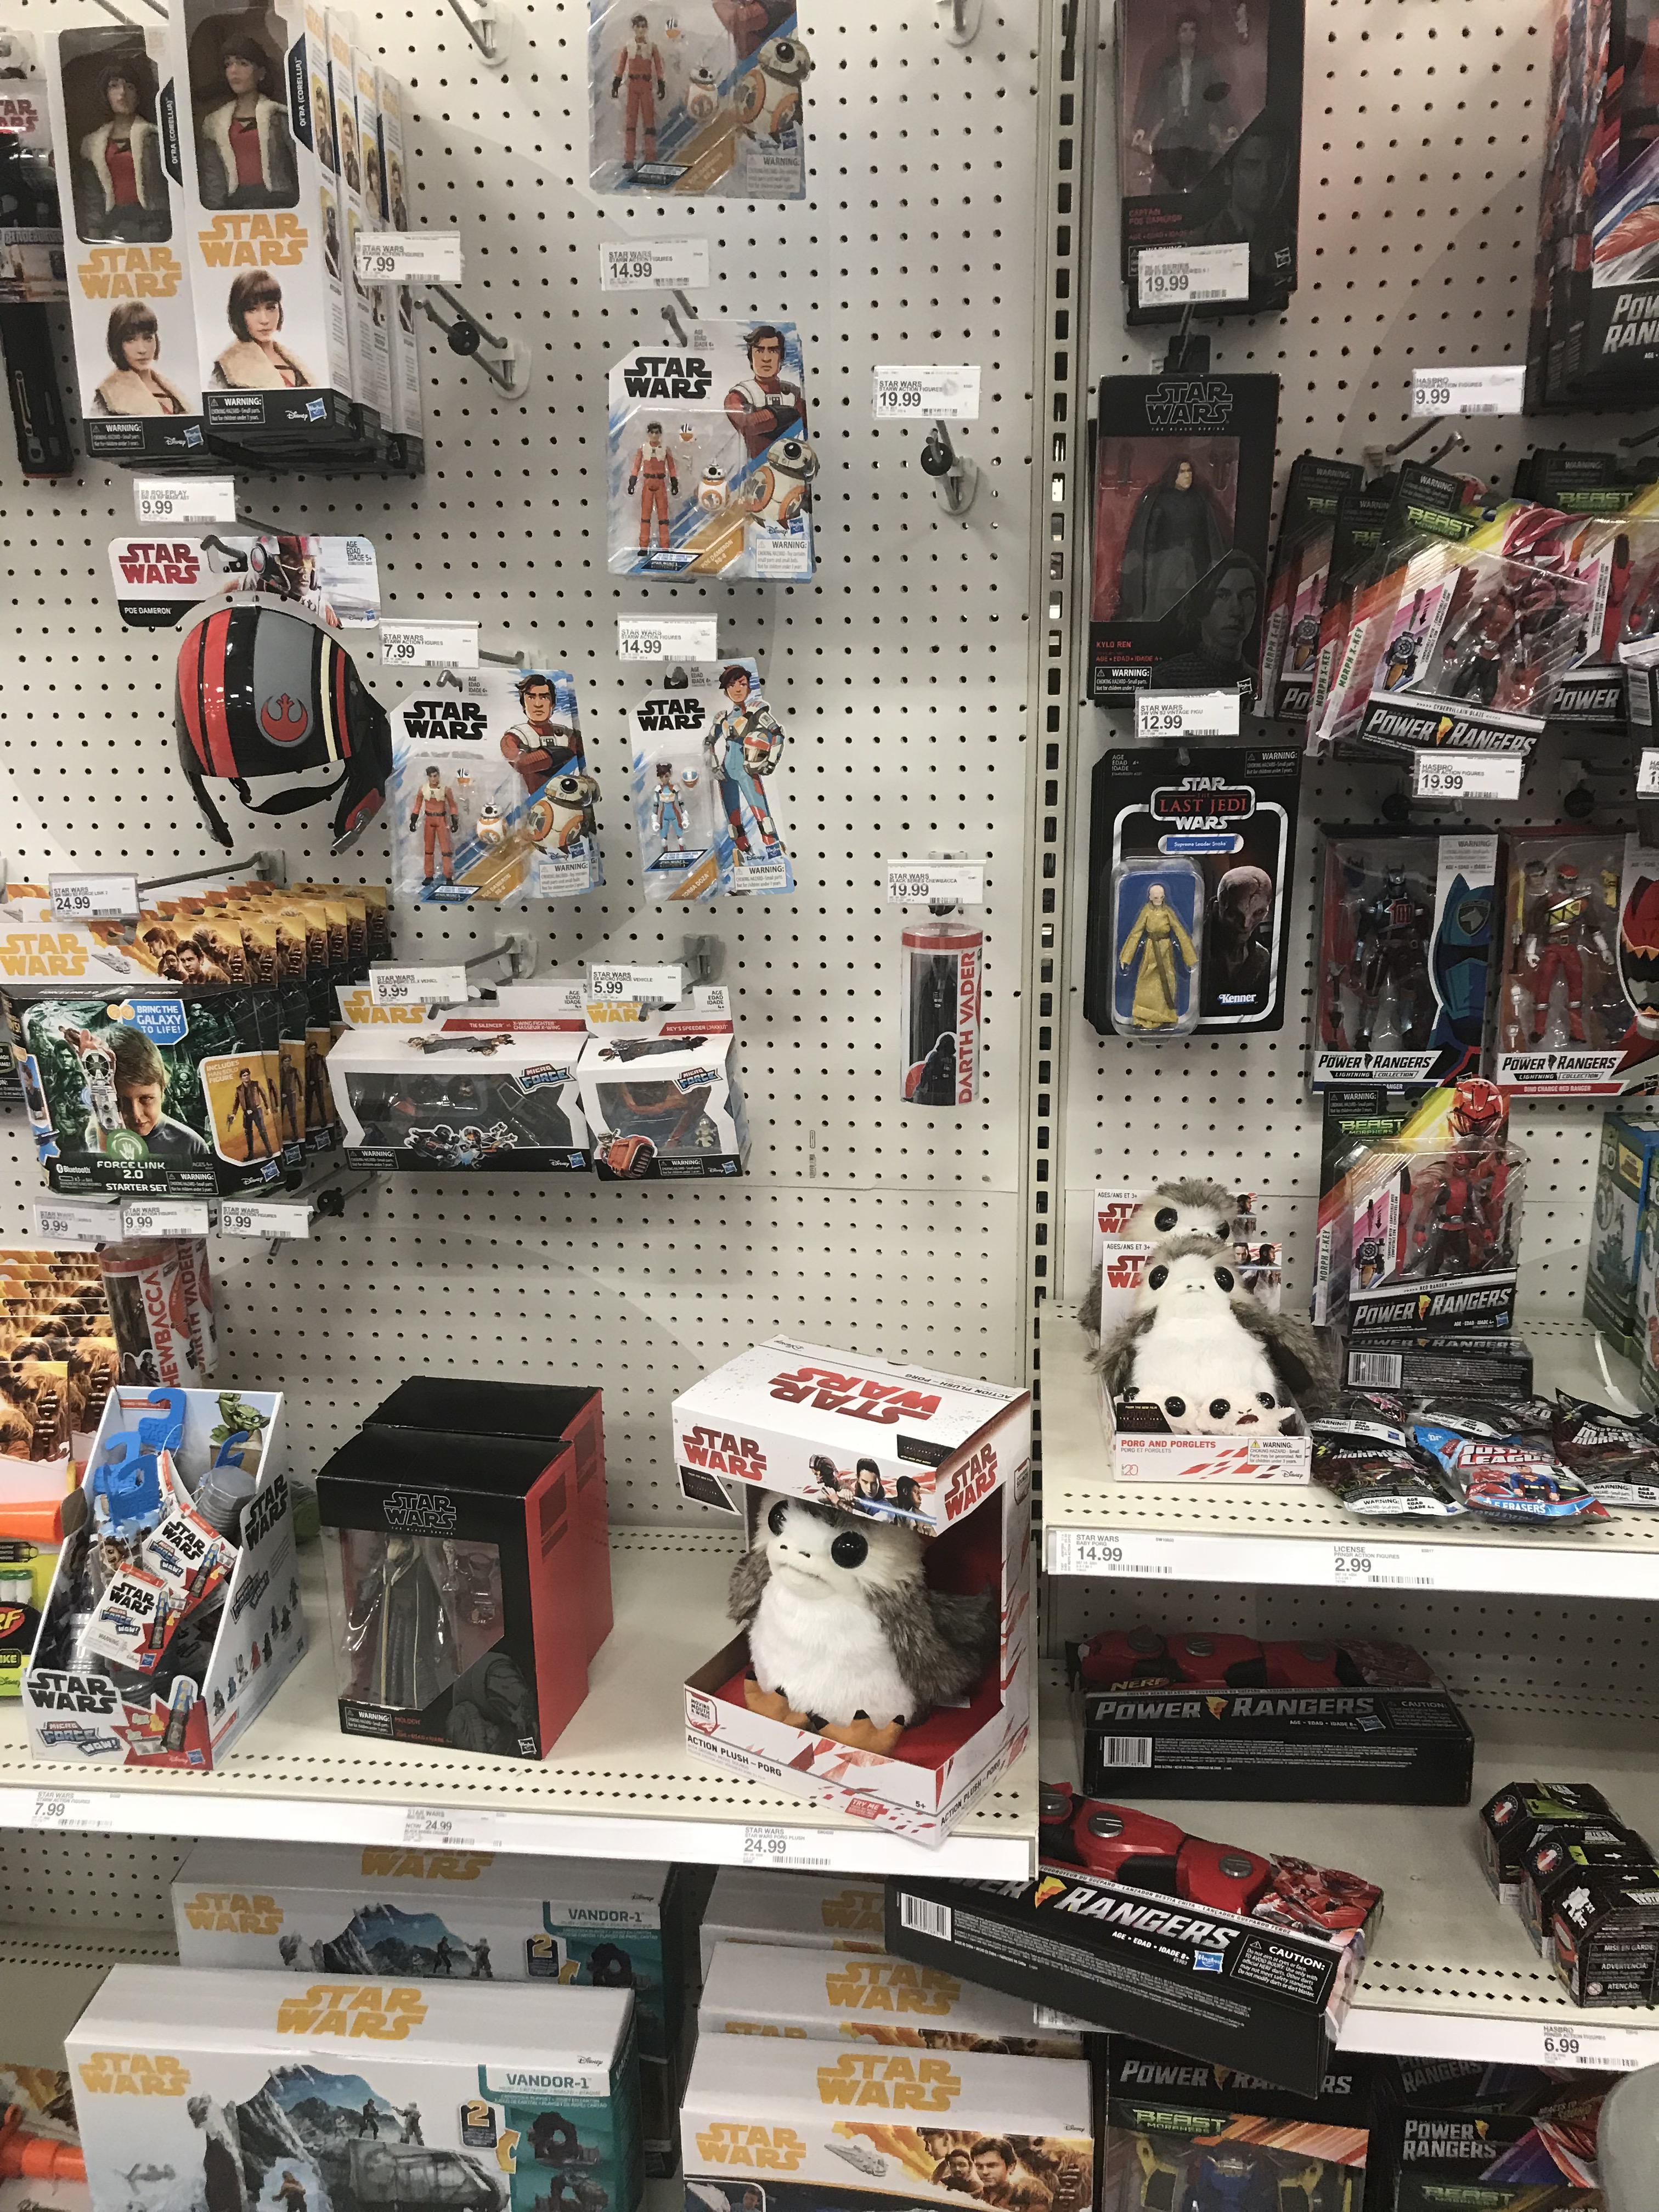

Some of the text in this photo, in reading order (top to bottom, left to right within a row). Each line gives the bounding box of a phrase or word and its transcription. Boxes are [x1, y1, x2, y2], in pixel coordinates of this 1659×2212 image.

[198, 214, 307, 240] STAR
[77, 247, 181, 273] STAR
[200, 240, 309, 267] WARS
[363, 257, 394, 271] 7.99
[610, 263, 652, 278] 14.99
[78, 274, 182, 298] WARS
[1146, 275, 1189, 292] 19.99
[624, 357, 712, 376] STAR
[624, 377, 712, 399] WARS
[1146, 382, 1232, 402] STAR
[1415, 389, 1449, 404] 9.99
[880, 392, 921, 407] 19.99
[1146, 403, 1232, 424] WARS
[142, 501, 173, 515] 9.99
[1407, 506, 1474, 535] BEAST
[119, 544, 199, 563] STAR
[119, 564, 200, 584] WARS
[384, 645, 414, 658] 7.99
[622, 640, 662, 653] 14.99
[403, 701, 487, 721] STAR
[637, 699, 705, 715] STAR
[403, 720, 487, 740] WARS
[638, 714, 706, 731] WARS
[1141, 716, 1182, 729] 12.99
[1370, 709, 1537, 754] POWER RANGERS
[1181, 777, 1226, 791] STAR
[1422, 775, 1463, 789] 19.99
[1160, 799, 1246, 814] LAST JEDI
[1176, 816, 1228, 830] WARS
[890, 884, 929, 896] 19.99
[57, 898, 91, 910] 24.99
[594, 982, 623, 994] 5.99
[1218, 994, 1256, 1003] Kenner
[137, 1015, 182, 1024] GALAXY
[958, 951, 975, 1104] DARTH VADER
[206, 1060, 239, 1070] INCLUDES
[1318, 1054, 1431, 1068] POWER RANGERS
[1502, 1056, 1616, 1071] POWER RANGERS
[123, 1170, 143, 1178] 2.0
[41, 1220, 68, 1231] 9.99
[223, 1215, 251, 1227] 9.99
[1355, 1288, 1511, 1326] POWER RANGERS
[143, 1270, 182, 1388] HEWBACCA
[683, 1425, 766, 1462] STAR
[683, 1443, 767, 1481] WARS
[944, 1443, 997, 1501] STAR
[944, 1460, 998, 1521] WARS
[383, 1492, 456, 1514] STAR
[1502, 1501, 1545, 1514] ERASERS
[384, 1507, 456, 1529] WARS
[1077, 1547, 1122, 1561] 14.99
[1335, 1558, 1371, 1572] 2.99
[27, 1679, 116, 1696] STAR
[1110, 1677, 1169, 1691] NERF
[29, 1689, 117, 1714] WARS
[1095, 1699, 1373, 1720] POWER RANGERS
[687, 1735, 782, 1776] ACTION PLUSH PORG
[34, 1803, 65, 1816] 7.99
[851, 1799, 867, 1809] TRY
[744, 1838, 786, 1854] 24.99
[1122, 1885, 1154, 1897] LANZADOR
[184, 1893, 283, 1914] STAR
[185, 1909, 283, 1935] WARS
[568, 1908, 642, 1922] VANDOR-1
[1054, 1887, 1240, 1949] RANGERS
[1269, 1946, 1325, 1971] CAUTION:
[281, 1984, 428, 2014] STAR
[826, 1981, 960, 2016] WARS
[277, 2008, 426, 2040] WARS
[1544, 2039, 1579, 2052] 6.99
[78, 2053, 190, 2075] STAR
[817, 2054, 961, 2085] STAR
[1121, 2061, 1206, 2085] POWER
[80, 2070, 190, 2096] WARS
[506, 2073, 589, 2089] VANDOR-1
[817, 2076, 961, 2112] WARS
[696, 2123, 806, 2149] STAR
[1404, 2120, 1472, 2140] POWER
[696, 2140, 806, 2171] WARS
[1404, 2140, 1496, 2159] RANGERS
